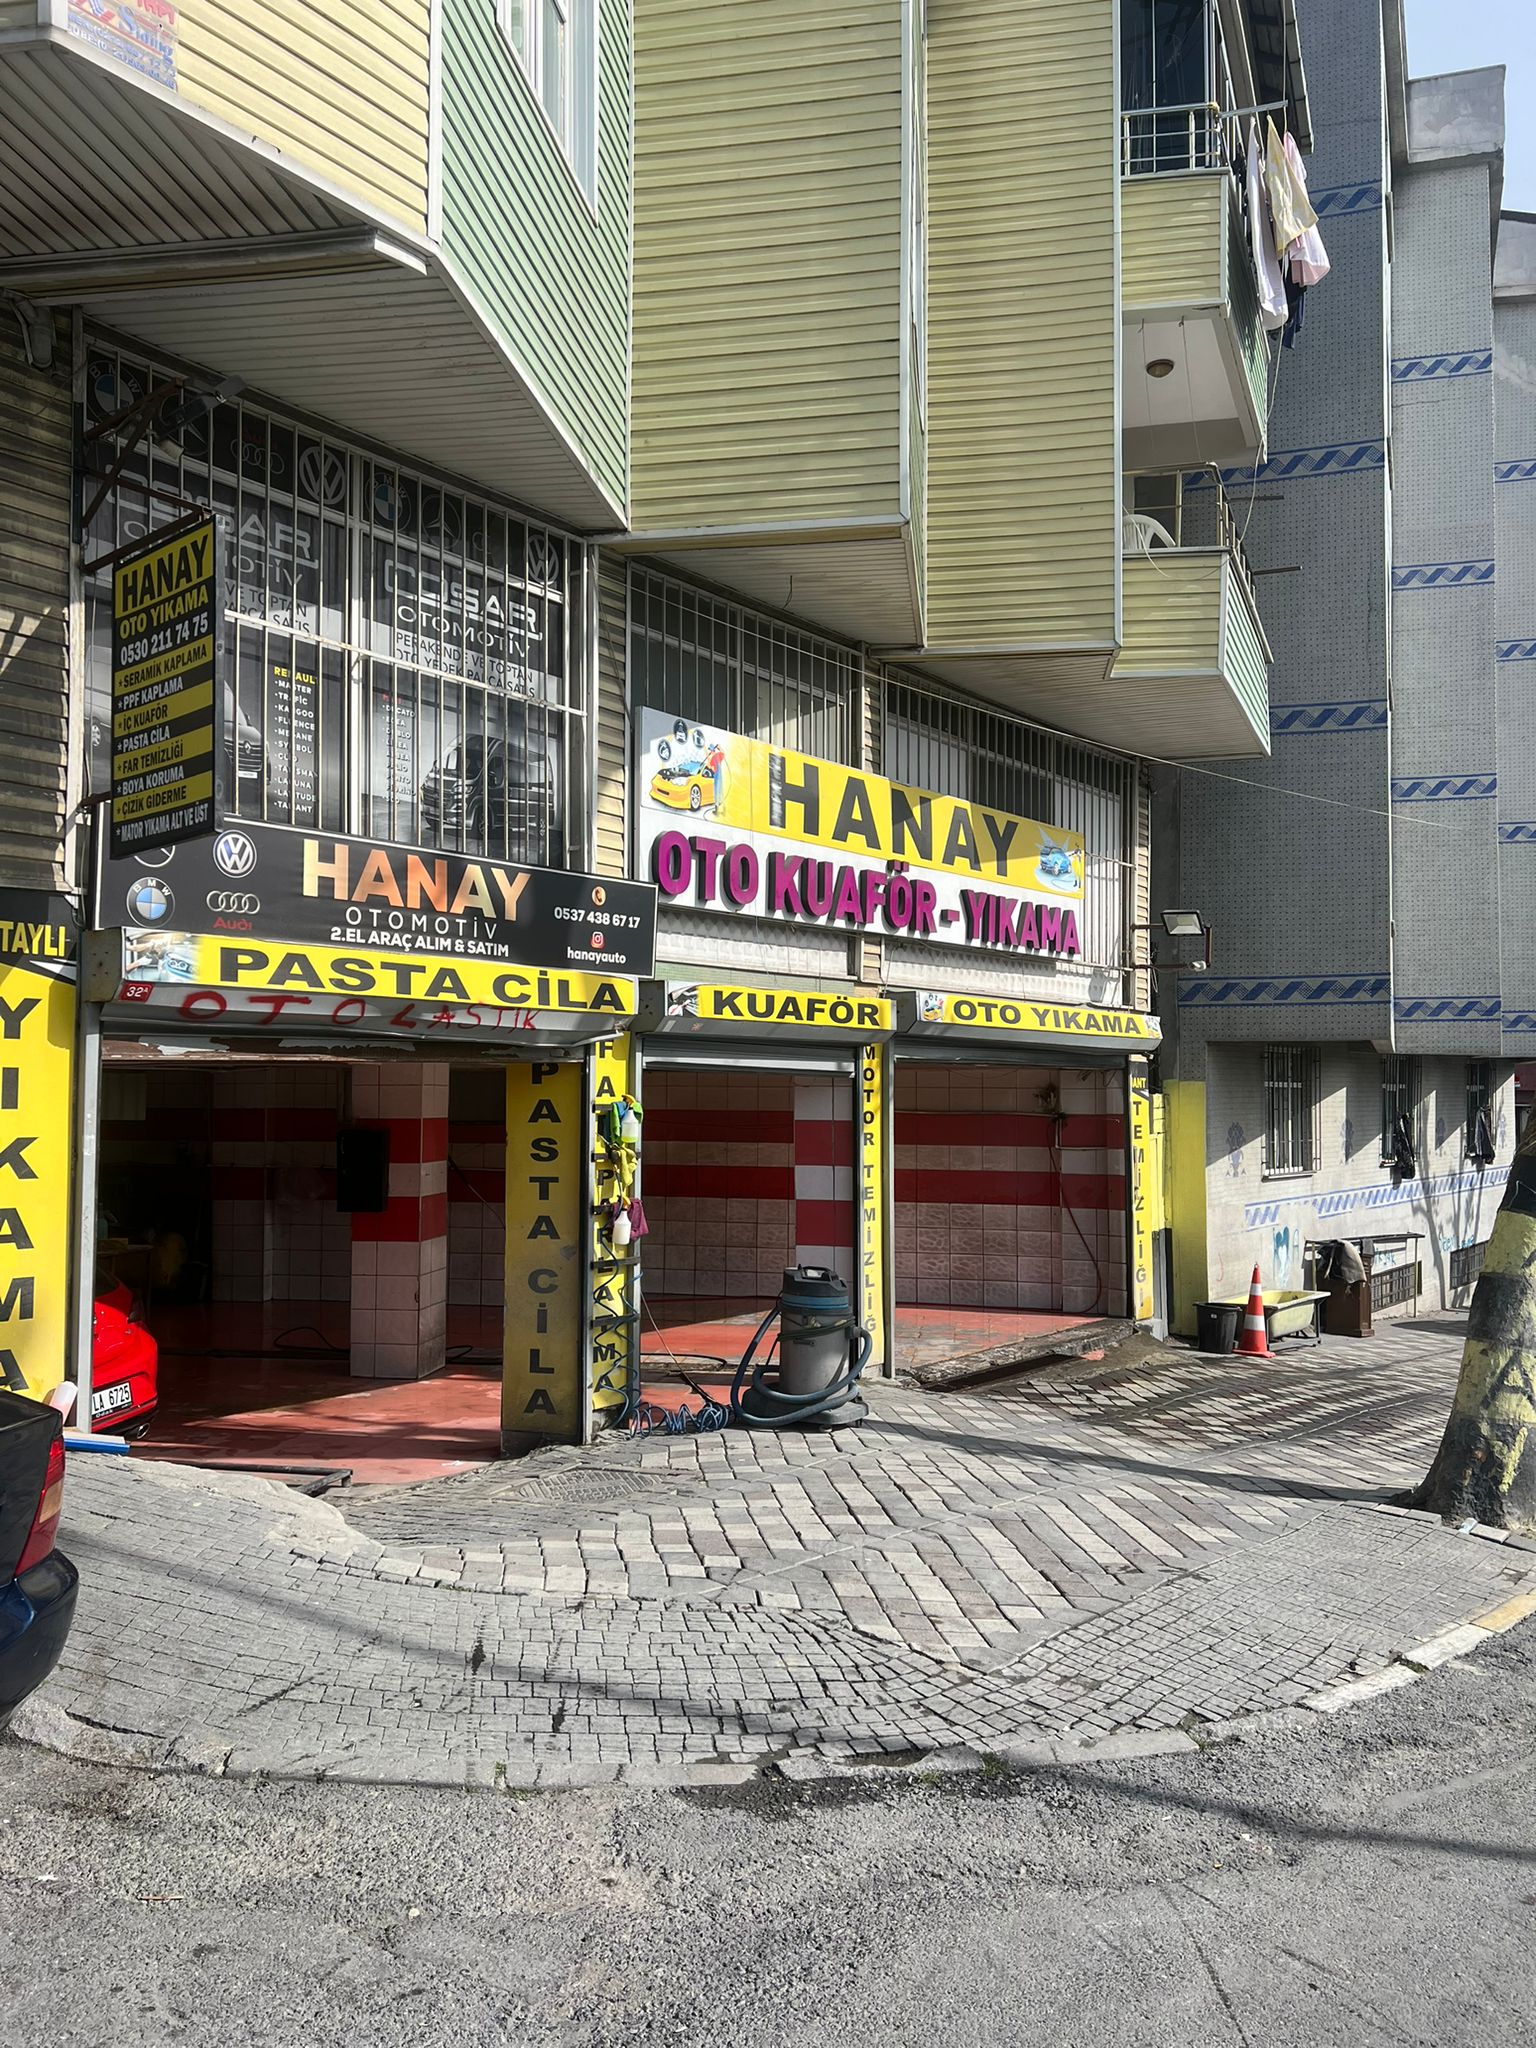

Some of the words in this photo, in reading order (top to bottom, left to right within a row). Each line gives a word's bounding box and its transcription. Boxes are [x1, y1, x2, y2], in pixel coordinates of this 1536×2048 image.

[122, 534, 208, 612] HANAY
[120, 613, 147, 639] OTO
[150, 584, 208, 627] YIKAMA
[121, 638, 148, 666] 0530
[151, 628, 173, 654] 211
[176, 620, 190, 644] 74
[193, 611, 208, 637] 75
[123, 661, 162, 688] SERAMİK
[164, 644, 207, 674] KAPLAMA
[123, 692, 140, 710] PPF
[141, 676, 184, 705] KAPLAMA
[134, 704, 168, 729] KUAFÖR
[278, 704, 314, 718] KAGOO
[123, 732, 149, 752] PASTA
[151, 725, 170, 744] CİLA
[278, 728, 312, 741] MEANE
[278, 741, 312, 753] SYBOL
[122, 758, 138, 774] FAR
[141, 739, 183, 768] TEMİZLİĞİ
[122, 778, 144, 795] BOYA
[146, 765, 184, 787] KORUMA
[278, 777, 312, 789] LAUNA
[122, 798, 144, 819] ÇİZİK
[146, 786, 187, 808] GİDERME
[769, 753, 1018, 877] HANAY
[121, 822, 144, 842] MATOR
[145, 815, 170, 837] YIKAMA
[171, 811, 183, 829] ALT
[184, 809, 194, 827] VE
[194, 802, 209, 824] ÜST
[133, 879, 171, 896] BMW
[302, 839, 531, 922] HANAY
[652, 830, 759, 905] OTO
[768, 850, 937, 934] KUAFÖR
[961, 889, 1081, 955] YIKAMA
[212, 917, 253, 930] Audi
[345, 907, 497, 940] OTOMOTİV
[554, 907, 584, 923] 0537
[586, 910, 610, 926] 438
[612, 913, 628, 927] 67
[628, 914, 641, 928] 17
[331, 926, 366, 943] 2.EL
[369, 930, 411, 951] ARAÇ
[413, 934, 452, 951] ALIM
[454, 939, 465, 953] &
[467, 940, 509, 957] SATIM
[567, 946, 627, 964] hanayauto
[220, 946, 471, 1001] PASTA
[492, 970, 626, 1012] CİLA
[713, 989, 880, 1027] KUAFÖR
[953, 1000, 1021, 1024] OTO
[1031, 1007, 1142, 1035] YIKAMA
[862, 1046, 876, 1146] MOTOR
[526, 1062, 561, 1240] PASTA
[0, 998, 41, 1391] YIKAMA
[523, 1268, 558, 1416] CİLA
[109, 1385, 130, 1406] 6725
